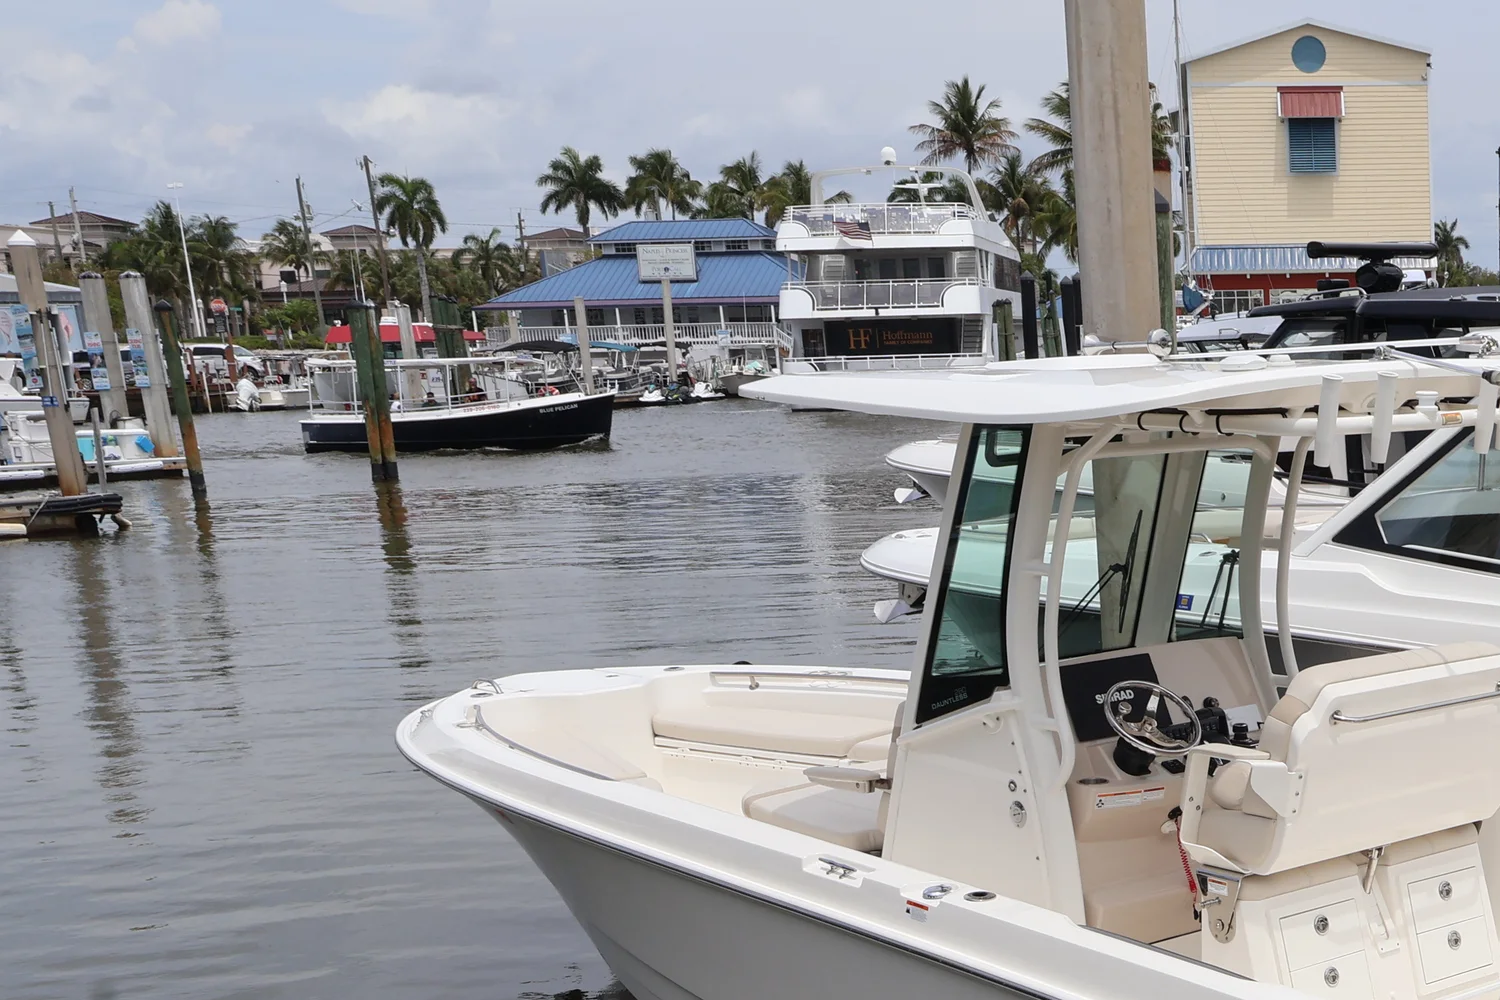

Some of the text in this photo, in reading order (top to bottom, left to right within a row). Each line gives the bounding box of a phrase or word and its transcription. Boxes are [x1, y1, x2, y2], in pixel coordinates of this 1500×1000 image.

[847, 328, 872, 349] HF
[883, 330, 933, 340] Hoffmann
[555, 403, 579, 412] PELICAN
[931, 692, 968, 710] DAUNTLESS
